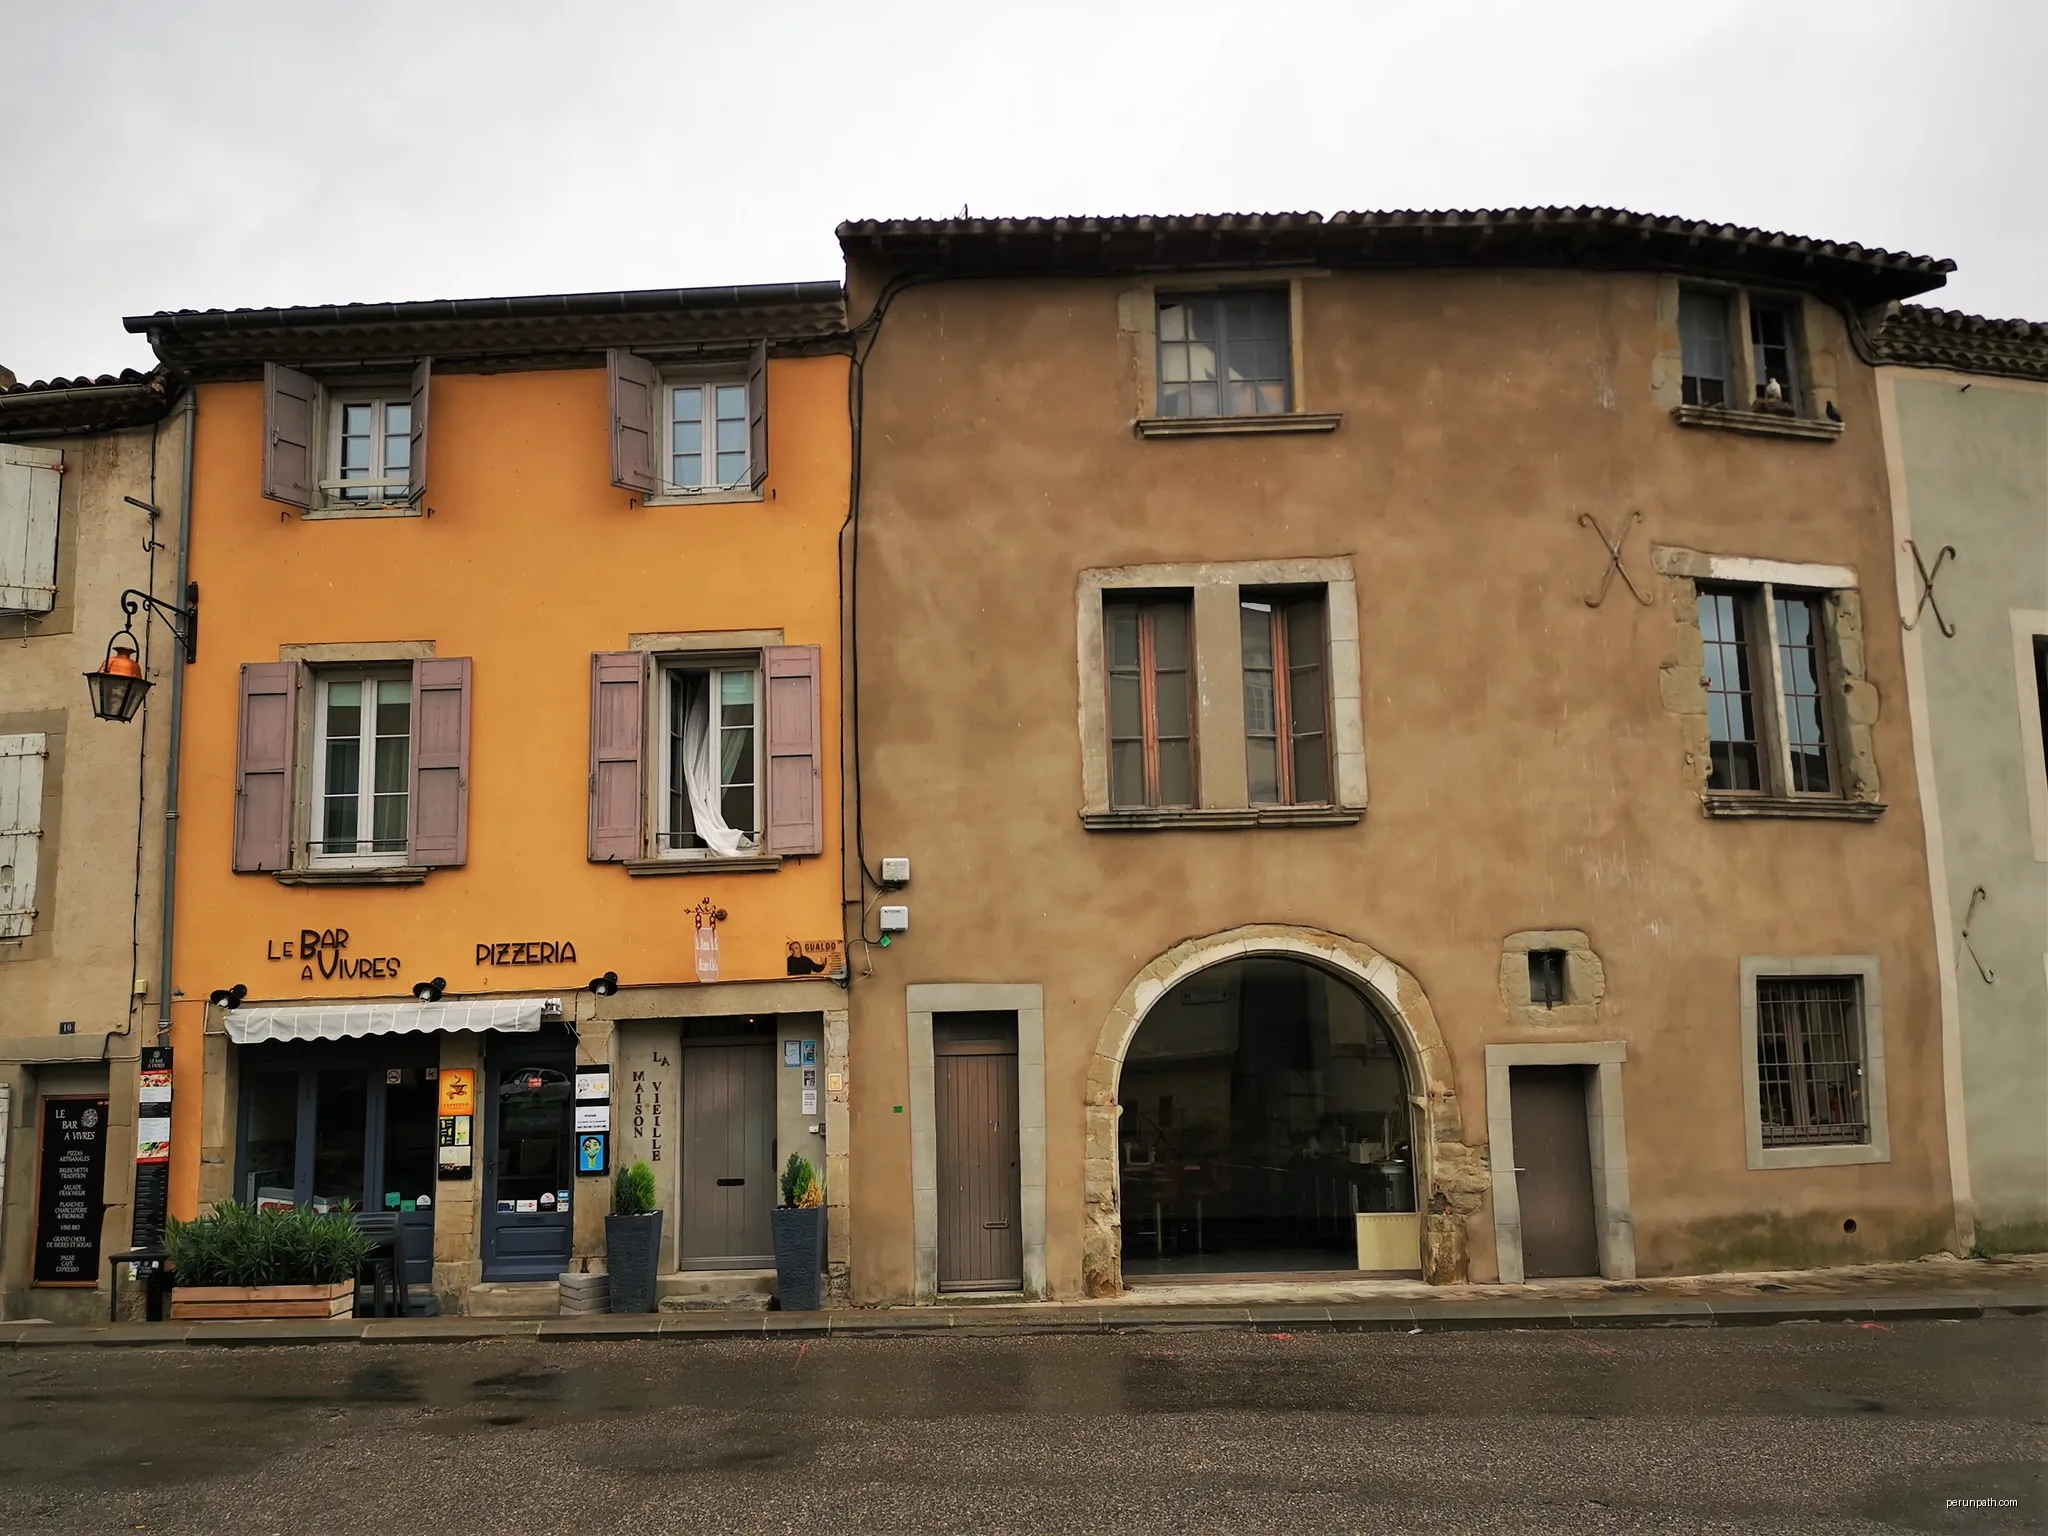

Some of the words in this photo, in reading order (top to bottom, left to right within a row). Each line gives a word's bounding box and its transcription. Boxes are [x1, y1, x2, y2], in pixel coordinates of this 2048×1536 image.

[268, 940, 293, 960] LE
[300, 928, 349, 959] BAR
[804, 942, 836, 951] GUALDO
[475, 941, 577, 966] PIZZERIA
[301, 965, 313, 980] A
[317, 949, 400, 979] VIVRES
[63, 1023, 72, 1032] 10
[652, 1051, 670, 1066] LA
[632, 1071, 645, 1138] MAISON
[55, 1109, 66, 1119] LE
[652, 1081, 662, 1161] VIEILLE
[62, 1120, 78, 1129] BAR
[64, 1131, 70, 1140] A
[72, 1131, 95, 1140] VIVRES
